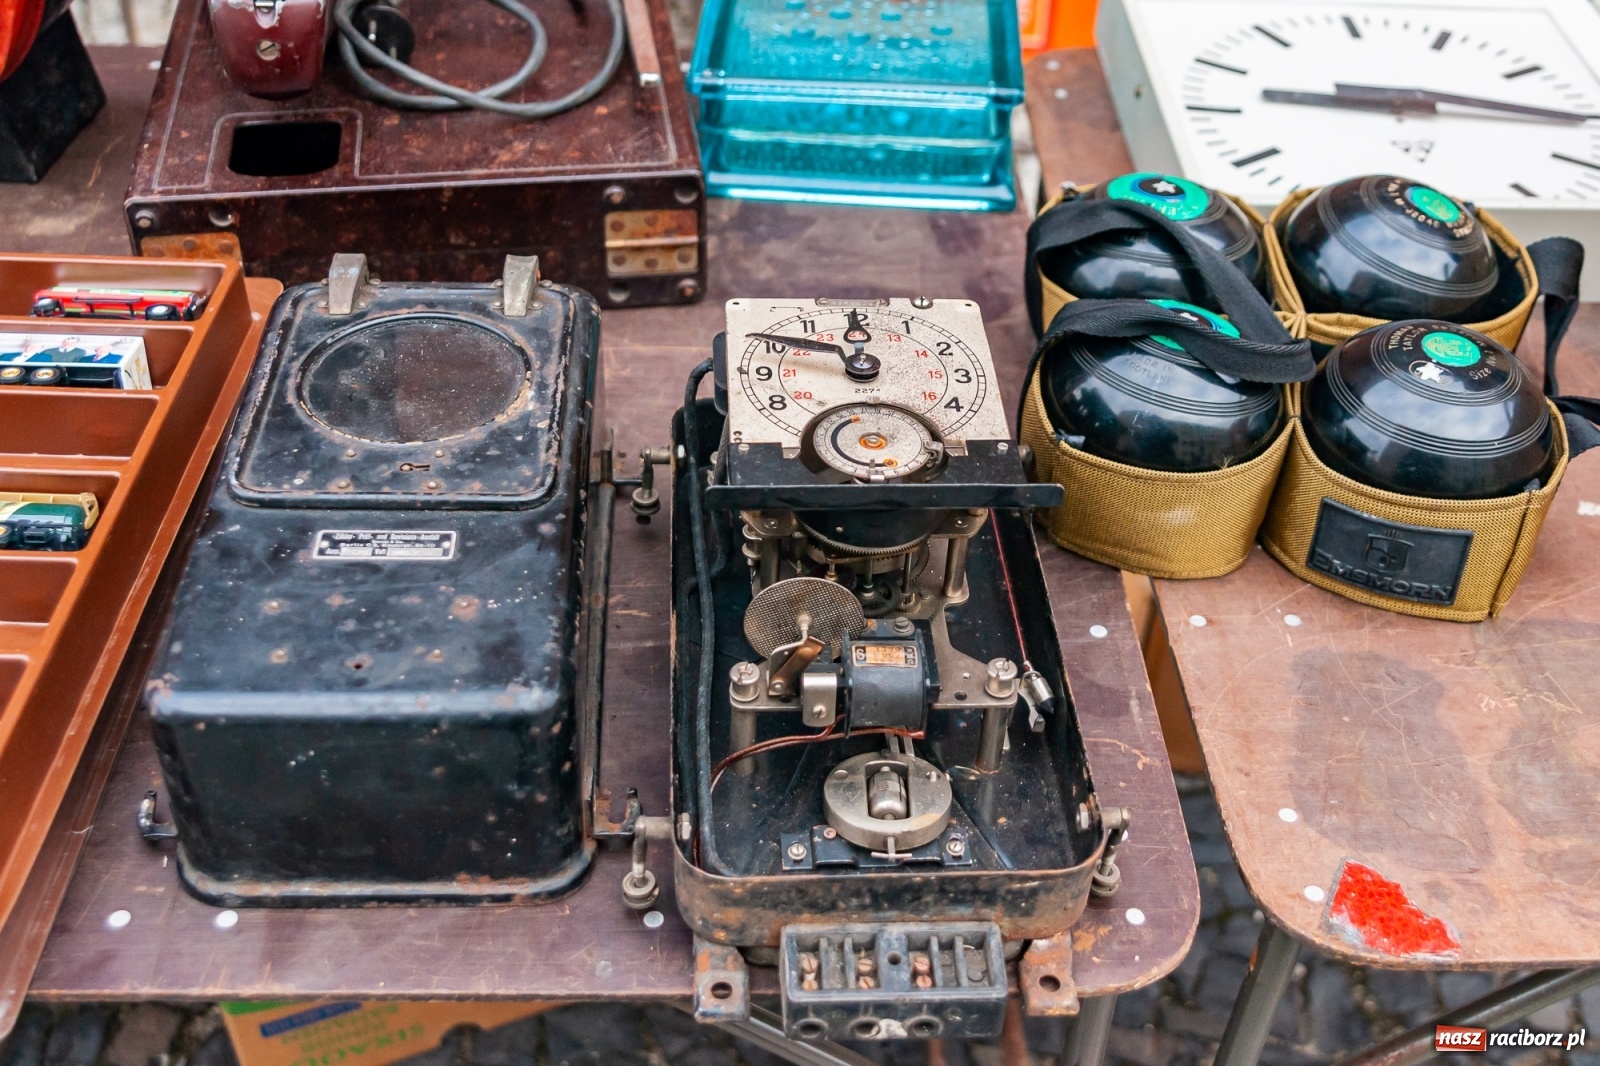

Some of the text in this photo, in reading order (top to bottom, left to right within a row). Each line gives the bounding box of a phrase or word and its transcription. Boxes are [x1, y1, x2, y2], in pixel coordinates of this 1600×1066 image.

[799, 319, 816, 334] 11
[843, 313, 870, 326] 12
[901, 320, 911, 335] 1
[816, 333, 835, 342] 23
[886, 334, 902, 343] 13
[1402, 327, 1428, 351] TAYLOR
[762, 340, 787, 354] 10
[914, 349, 929, 358] 14
[936, 341, 954, 357] 2
[755, 365, 773, 382] 9
[782, 368, 797, 378] 21
[927, 370, 943, 379] 15
[953, 368, 972, 384] 3
[1468, 367, 1492, 380] Size
[768, 394, 788, 410] 8
[793, 390, 813, 400] 20
[921, 391, 937, 401] 16
[943, 396, 965, 412] 4
[1313, 546, 1454, 601] EMSMORN
